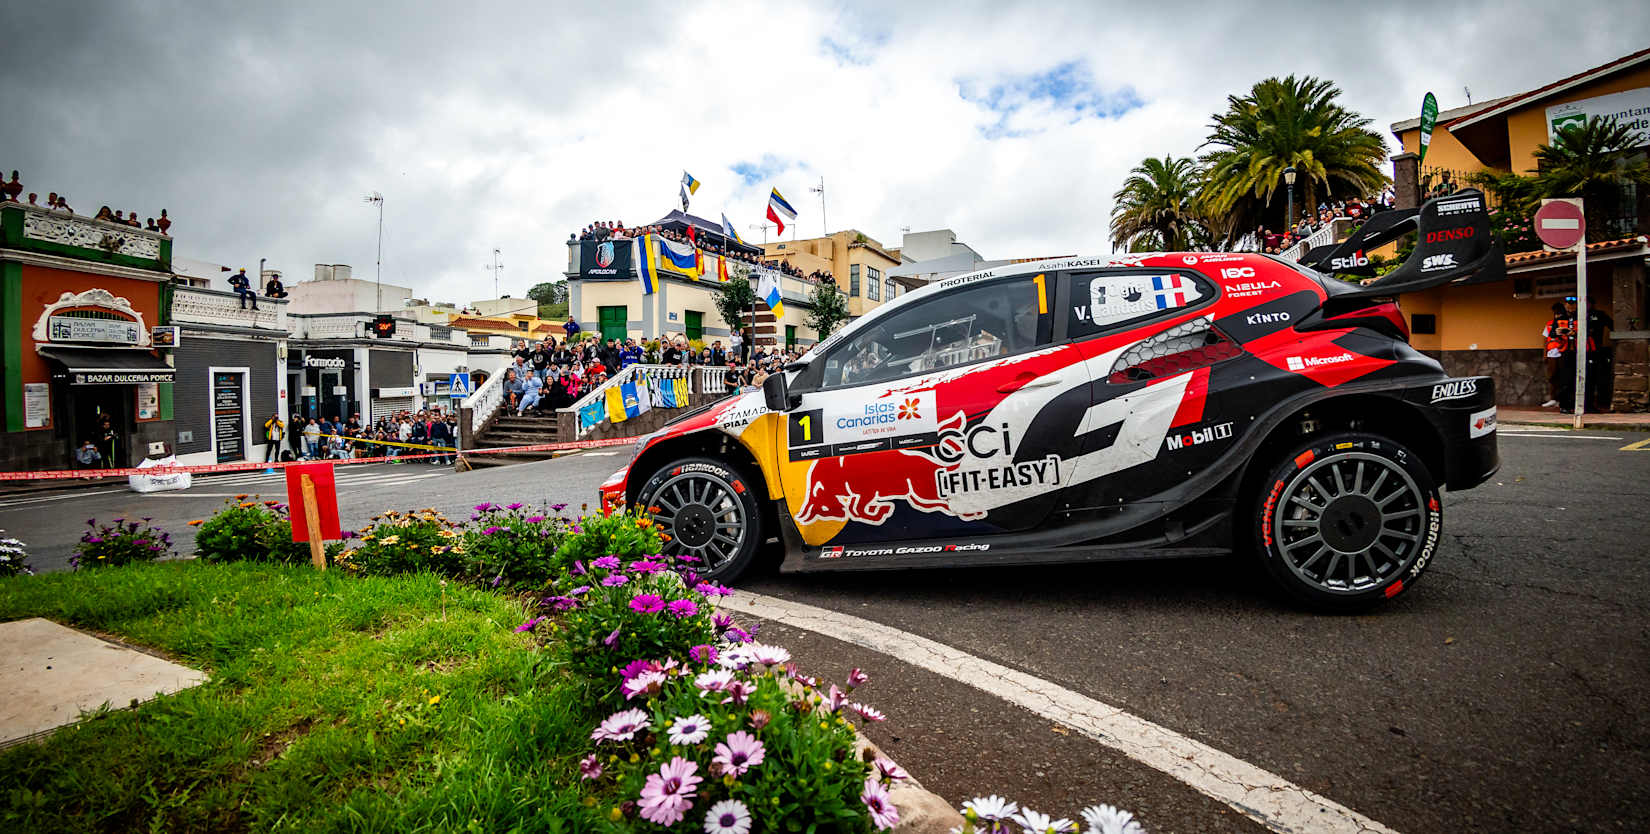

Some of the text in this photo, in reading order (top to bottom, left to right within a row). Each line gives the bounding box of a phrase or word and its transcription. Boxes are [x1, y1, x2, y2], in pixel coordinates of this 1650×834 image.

[1426, 226, 1475, 244] DENSO
[1331, 249, 1369, 270] Stilo
[940, 271, 996, 289] PROTERIAL
[1033, 273, 1049, 314] 1
[1228, 290, 1263, 298] FOREST
[1074, 305, 1091, 321] V.
[1246, 312, 1291, 325] KINTO
[1304, 353, 1354, 366] Microsoft
[87, 374, 173, 383] BAZAR DULCERIA PONCE
[1431, 379, 1477, 400] ENDLESS
[865, 402, 896, 416] Islas
[723, 419, 749, 430] PIAA
[798, 415, 811, 441] 1
[836, 413, 897, 430] Canarias
[1166, 427, 1214, 450] Mobil
[846, 549, 893, 557] TOYOTA
[896, 546, 942, 555] GAZOO
[944, 544, 990, 552] Racing
